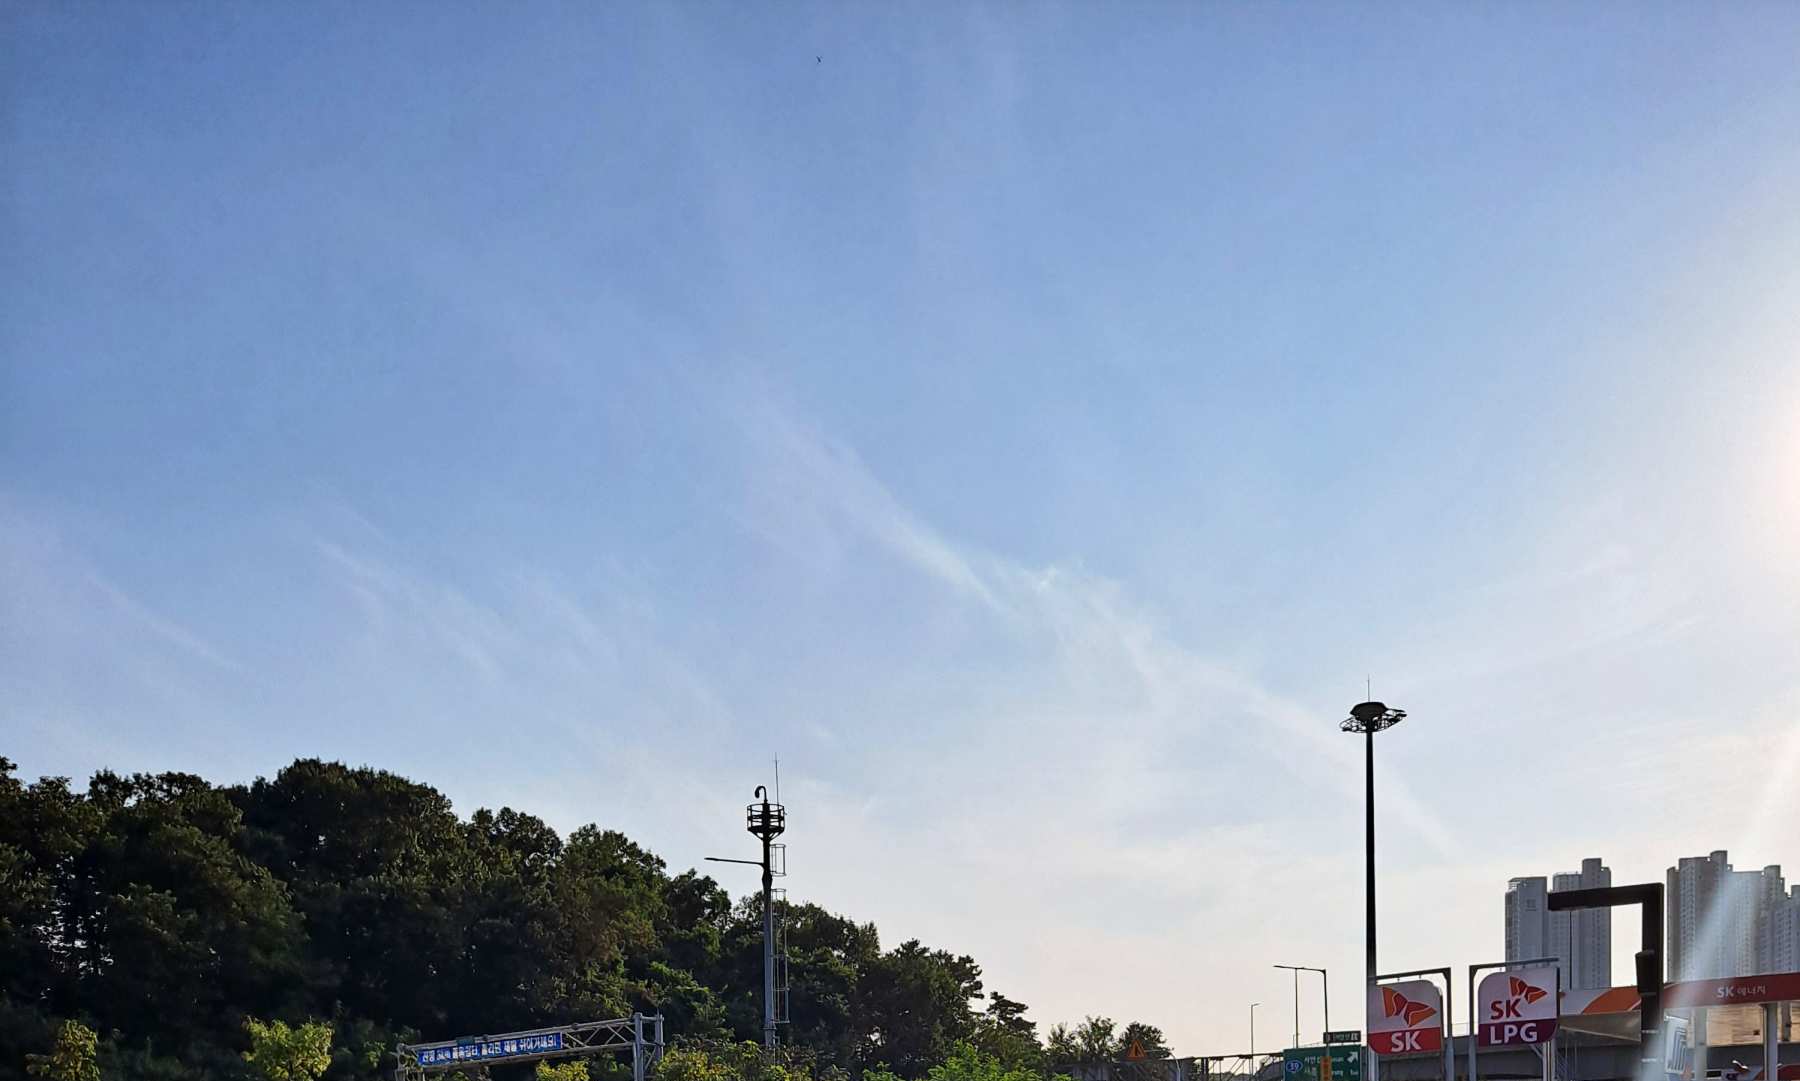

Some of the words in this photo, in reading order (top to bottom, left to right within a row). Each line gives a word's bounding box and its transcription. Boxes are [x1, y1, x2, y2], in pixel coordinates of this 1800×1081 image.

[1717, 986, 1734, 998] SK
[1490, 998, 1521, 1020] SK
[1391, 1030, 1422, 1052] SK
[1490, 1022, 1538, 1045] LPG
